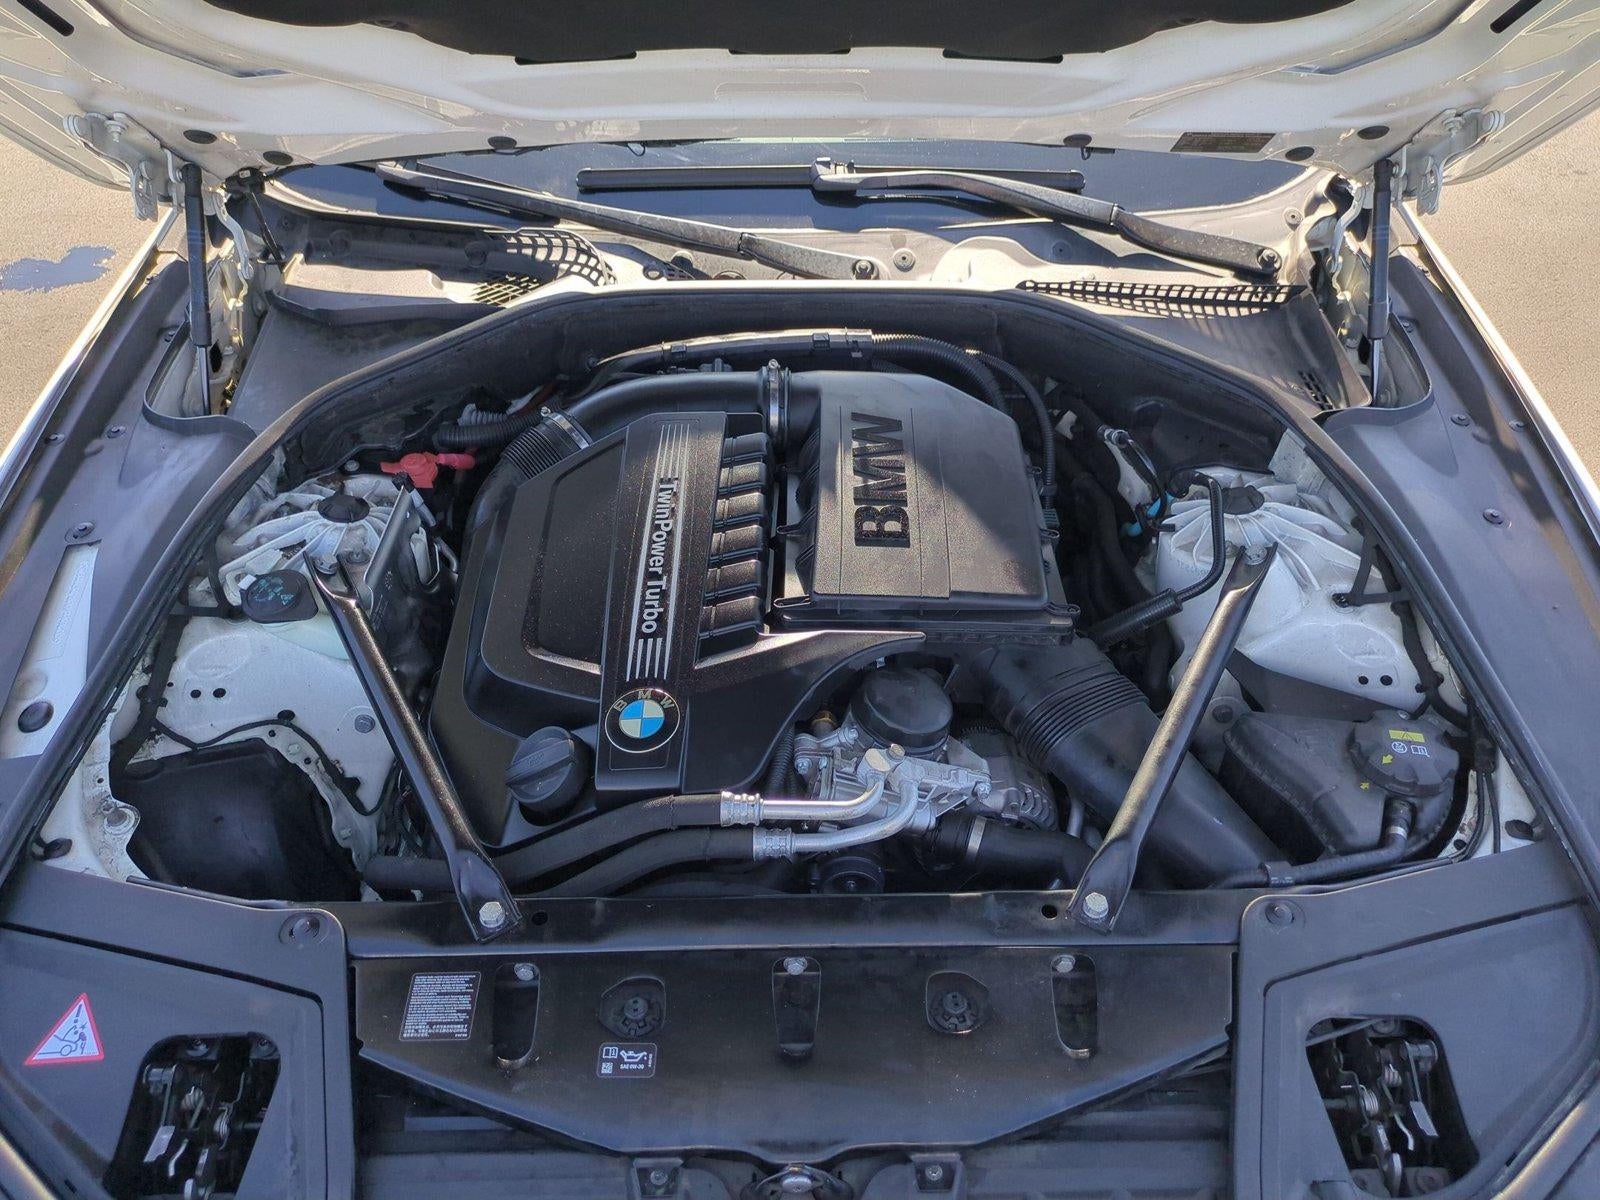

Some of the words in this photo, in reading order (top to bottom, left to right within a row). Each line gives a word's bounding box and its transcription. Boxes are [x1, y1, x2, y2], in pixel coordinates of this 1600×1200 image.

[851, 411, 910, 548] BMW
[649, 479, 678, 574] TwinPower
[641, 575, 667, 634] Turbo
[613, 689, 675, 712] BMW
